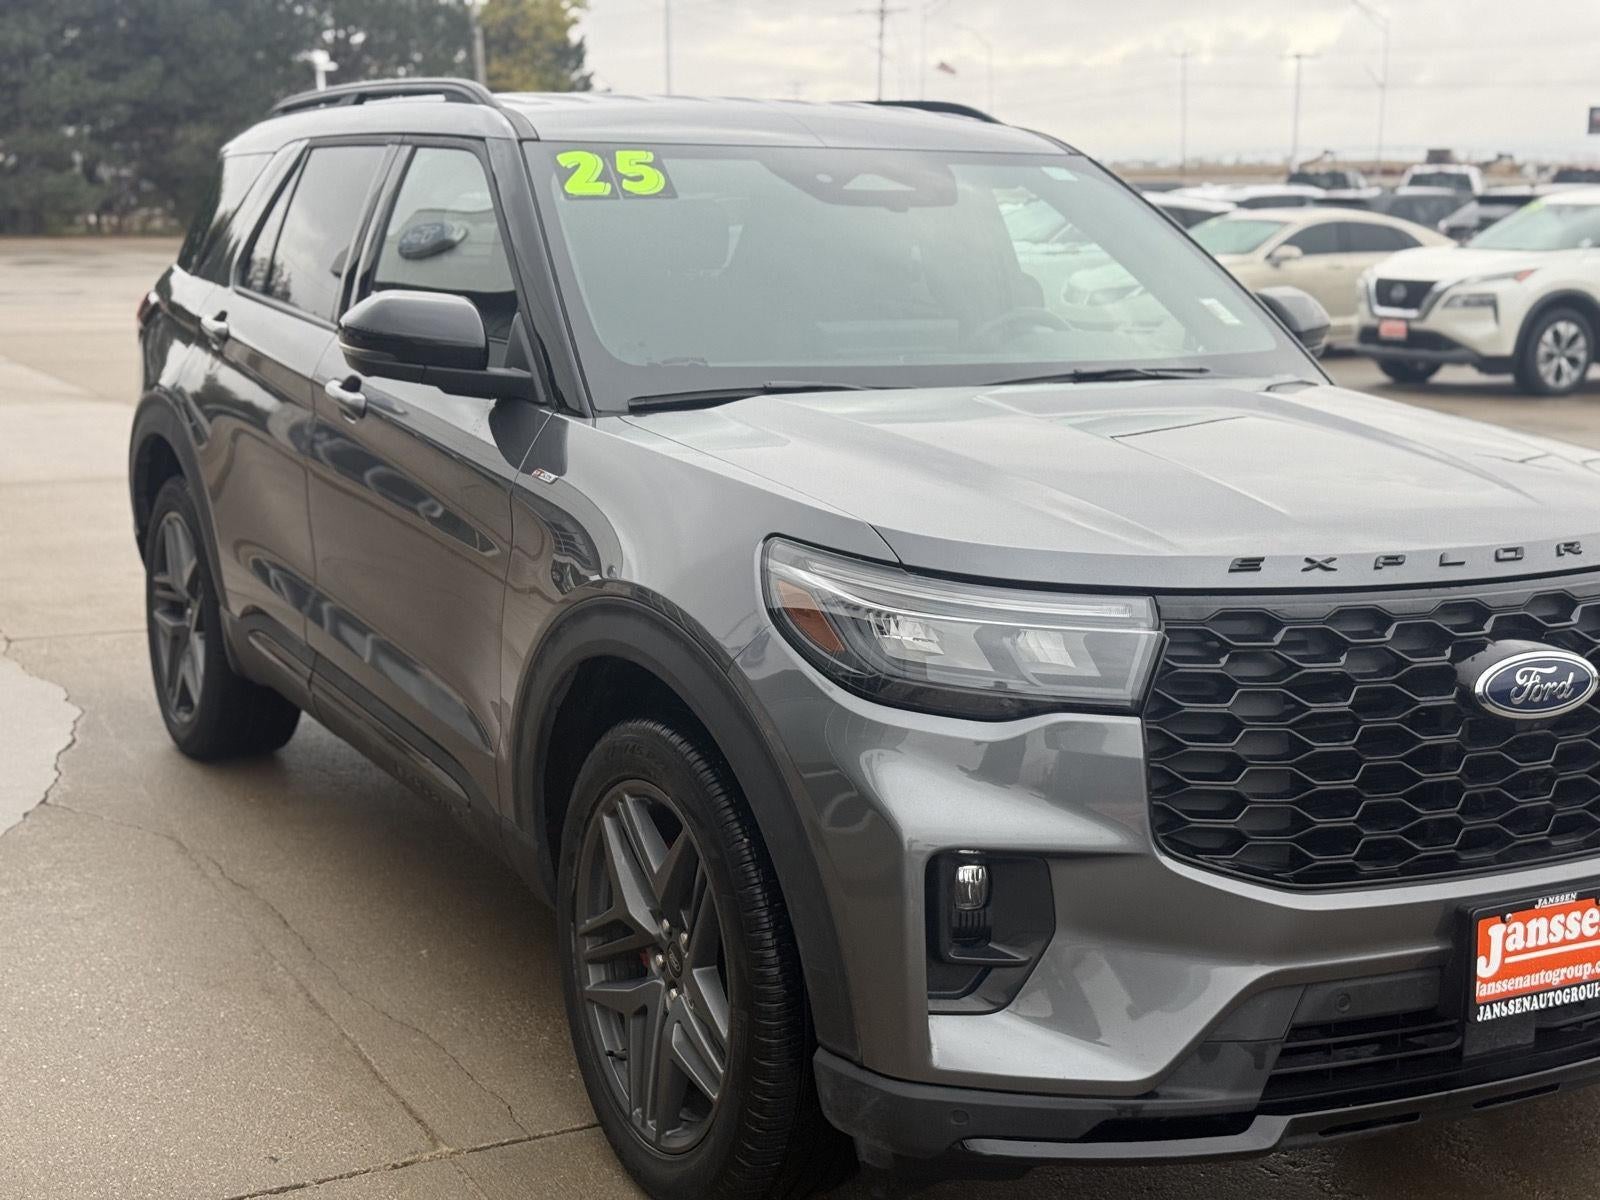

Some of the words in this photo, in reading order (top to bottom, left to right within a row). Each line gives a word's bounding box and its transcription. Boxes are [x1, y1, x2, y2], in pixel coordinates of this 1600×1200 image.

[556, 151, 666, 196] 25
[1228, 540, 1583, 574] EXPLOR
[1510, 666, 1574, 704] Ford
[1535, 892, 1577, 909] JANSSEN
[1477, 907, 1600, 978] Jansse
